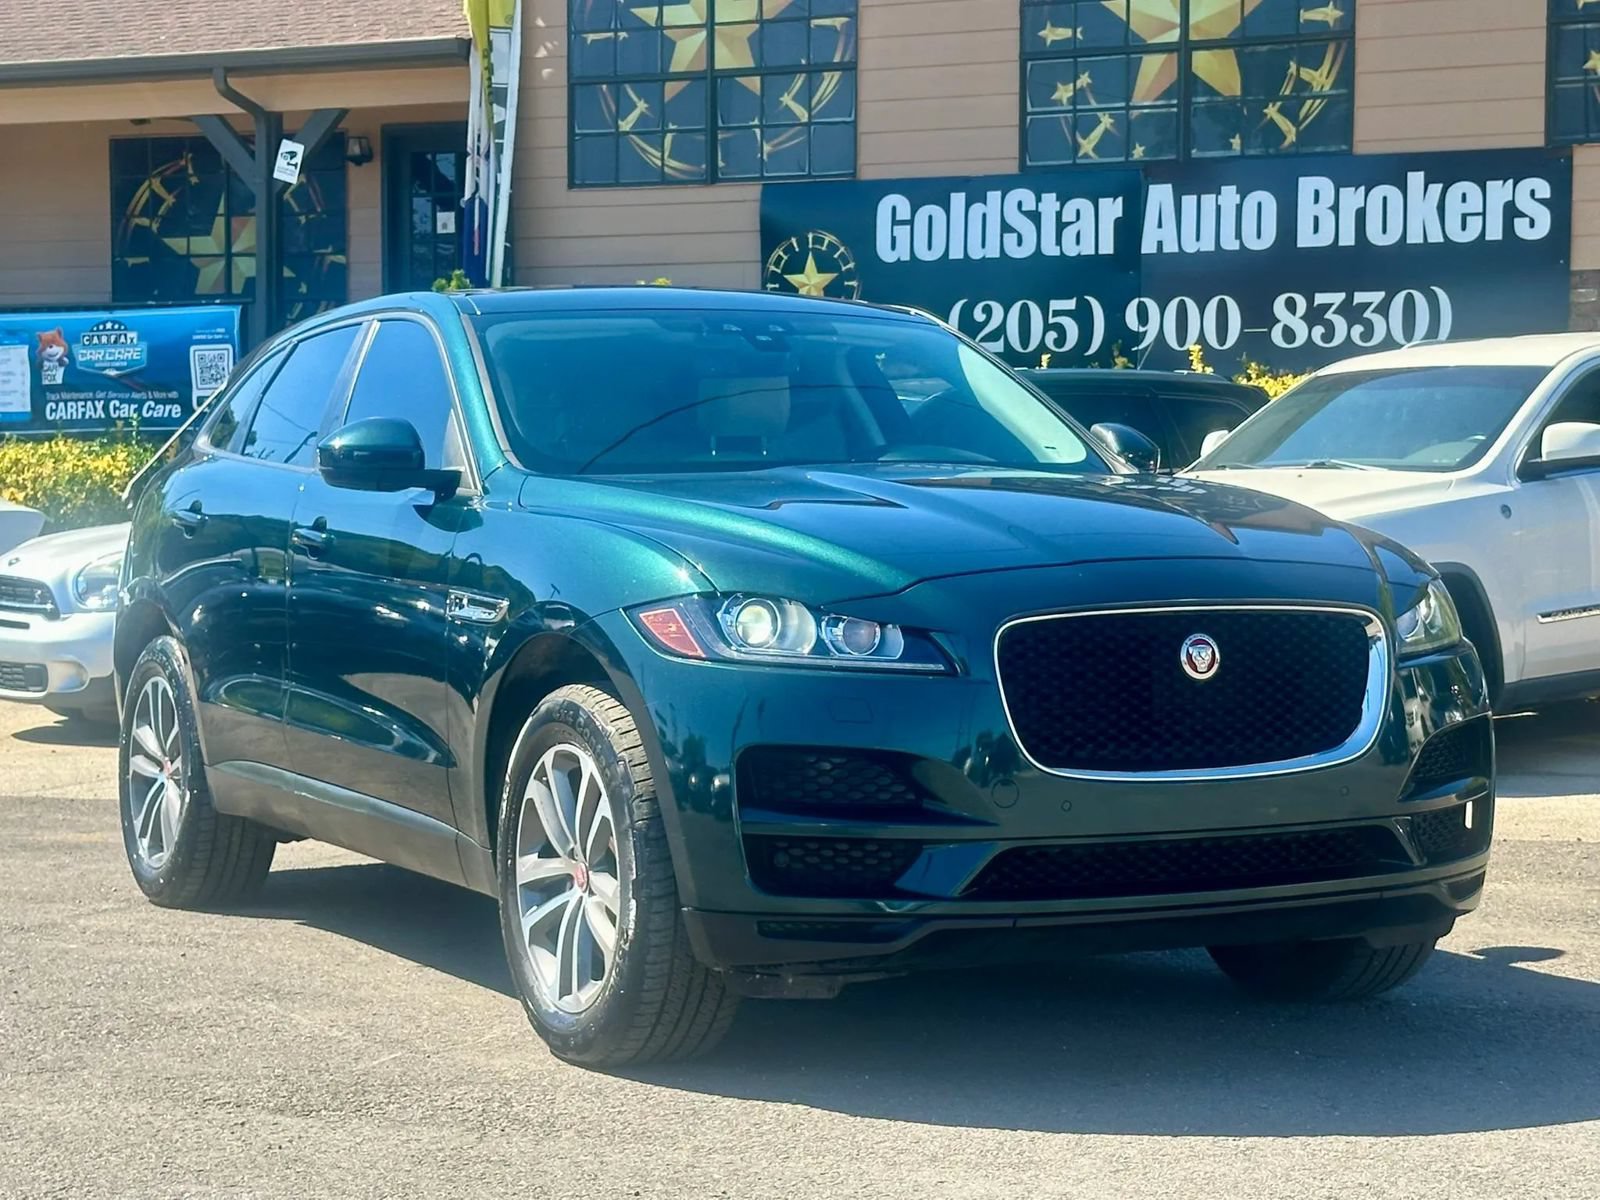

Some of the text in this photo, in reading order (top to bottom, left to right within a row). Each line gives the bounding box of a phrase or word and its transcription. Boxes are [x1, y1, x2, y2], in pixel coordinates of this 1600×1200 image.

[876, 170, 1551, 263] GoldStar Auto Brokers
[948, 295, 1105, 356] (205)
[82, 332, 137, 346] CARFAX
[78, 347, 142, 361] CAR CARE
[45, 399, 181, 420] CARFAX Car Care
